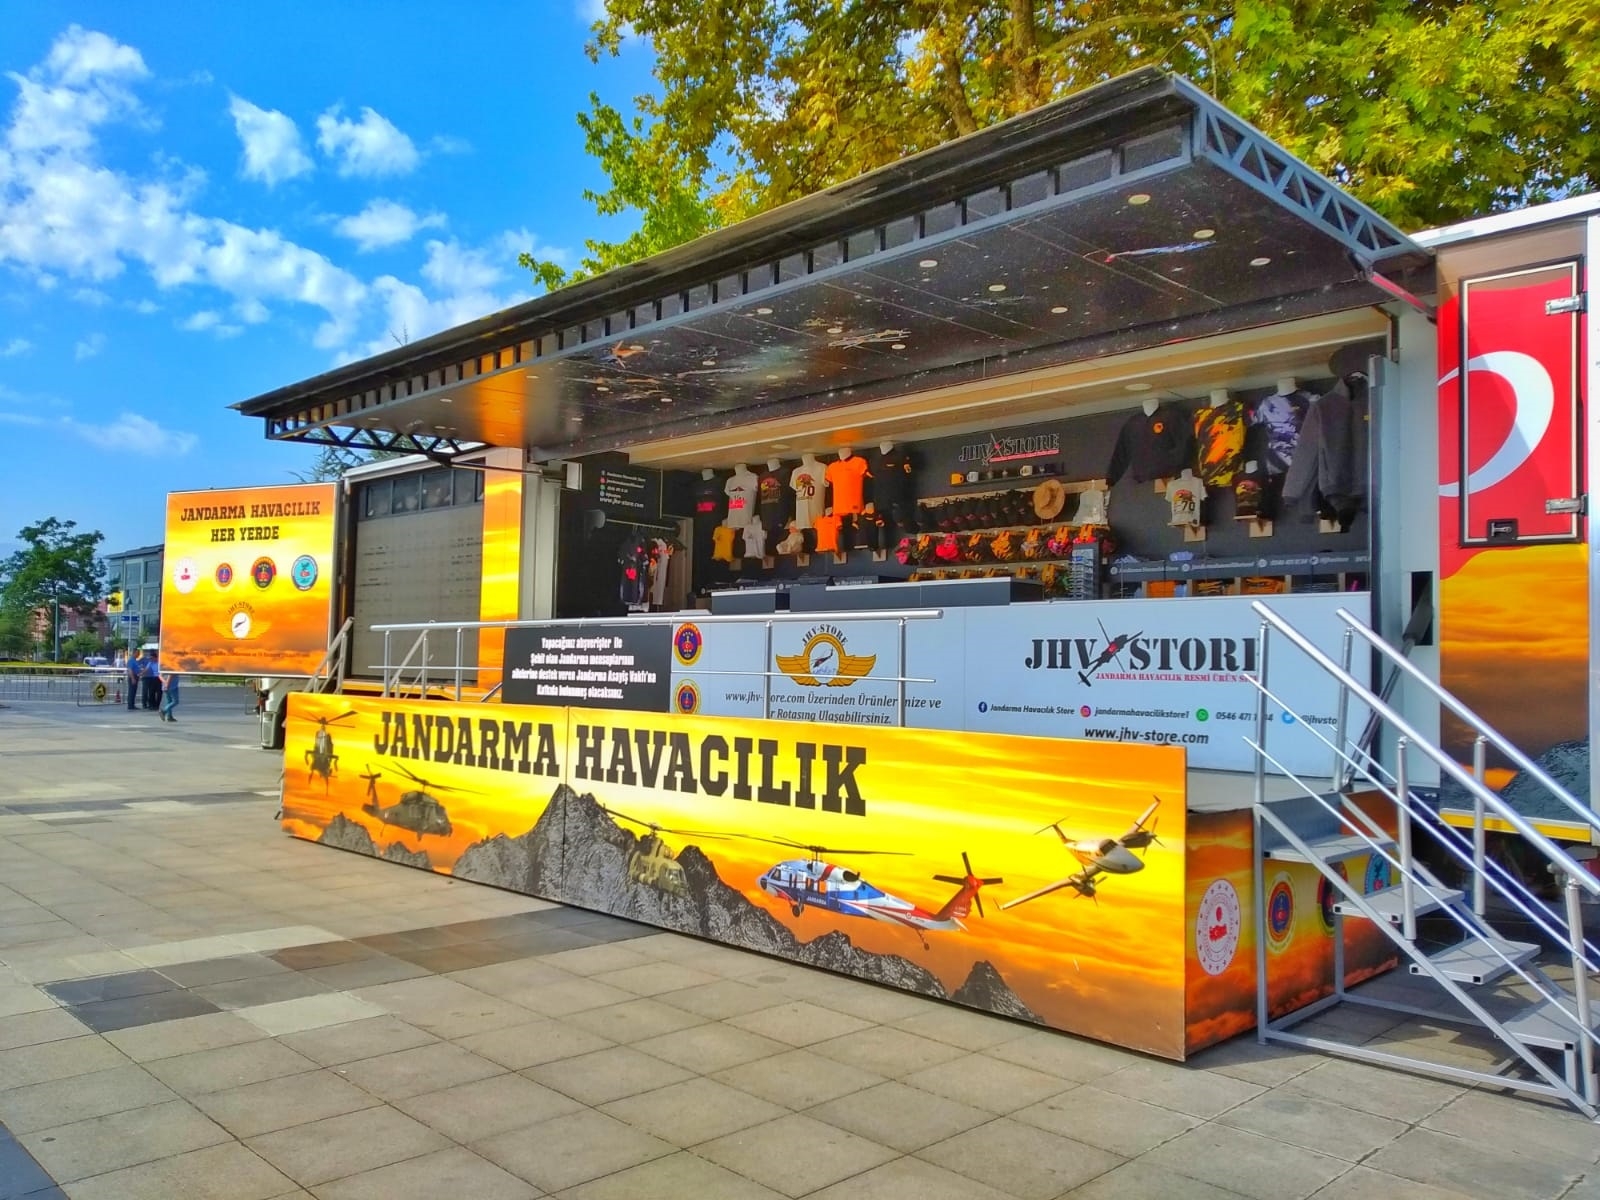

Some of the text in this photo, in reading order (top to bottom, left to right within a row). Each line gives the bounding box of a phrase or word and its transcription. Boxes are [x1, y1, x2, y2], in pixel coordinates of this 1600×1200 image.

[181, 501, 320, 521] JANDARMA HAVACILIK
[1181, 501, 1196, 511] 70
[211, 526, 279, 542] HER YERDE
[559, 653, 589, 665] Jandarma
[1024, 638, 1098, 670] JHV
[539, 668, 557, 680] destek
[558, 671, 576, 681] veren
[576, 669, 607, 682] Jandarma
[607, 670, 629, 685] Asayiş
[1095, 672, 1137, 680] JANDARMA
[1138, 673, 1182, 681] HAVACILIK
[725, 690, 942, 709] www.jhv-ore.com Üzerinden Ürünlermize ve
[990, 704, 1022, 713] Jandarma
[1056, 706, 1075, 715] Store
[1084, 725, 1209, 744] www.jhv-store.com
[374, 711, 867, 817] JANDARMA HAVACILIK
